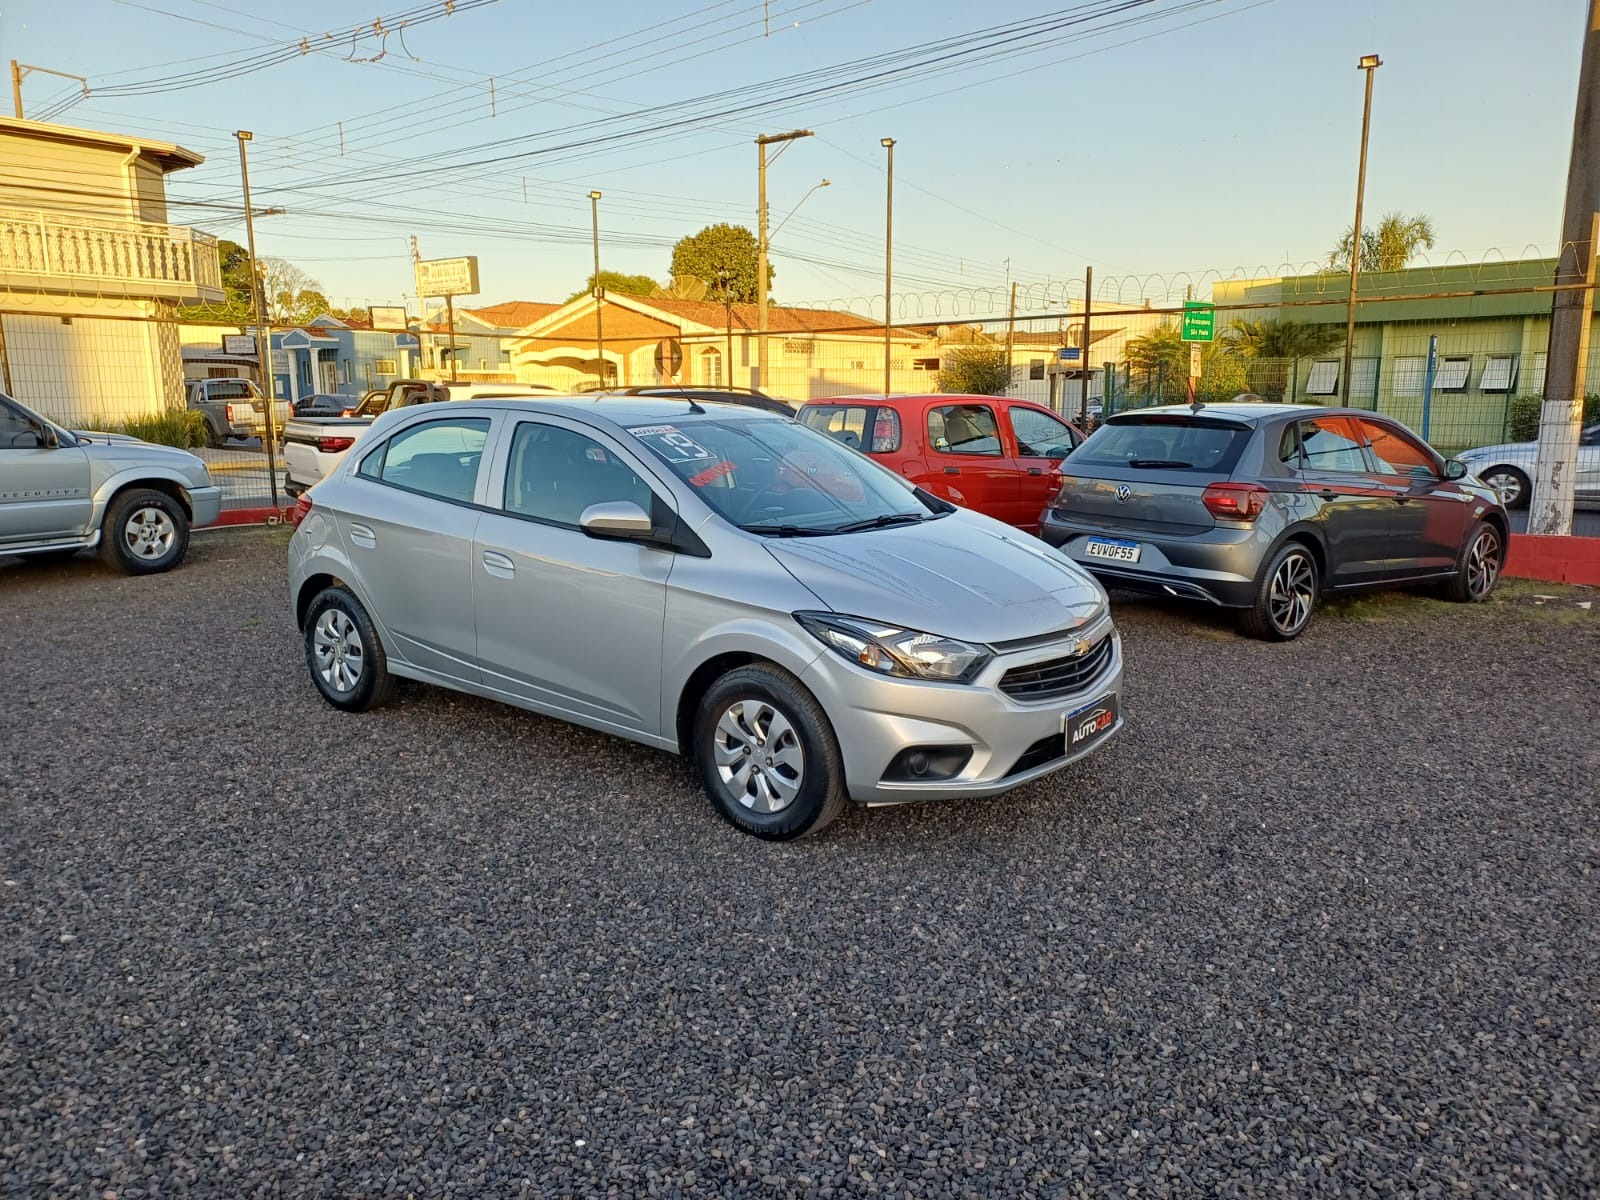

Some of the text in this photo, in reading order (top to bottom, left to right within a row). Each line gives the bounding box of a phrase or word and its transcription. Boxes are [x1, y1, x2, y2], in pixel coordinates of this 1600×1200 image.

[660, 433, 709, 458] 19
[1, 488, 81, 498] XECUTIVE
[1072, 711, 1113, 744] AUTOCAR
